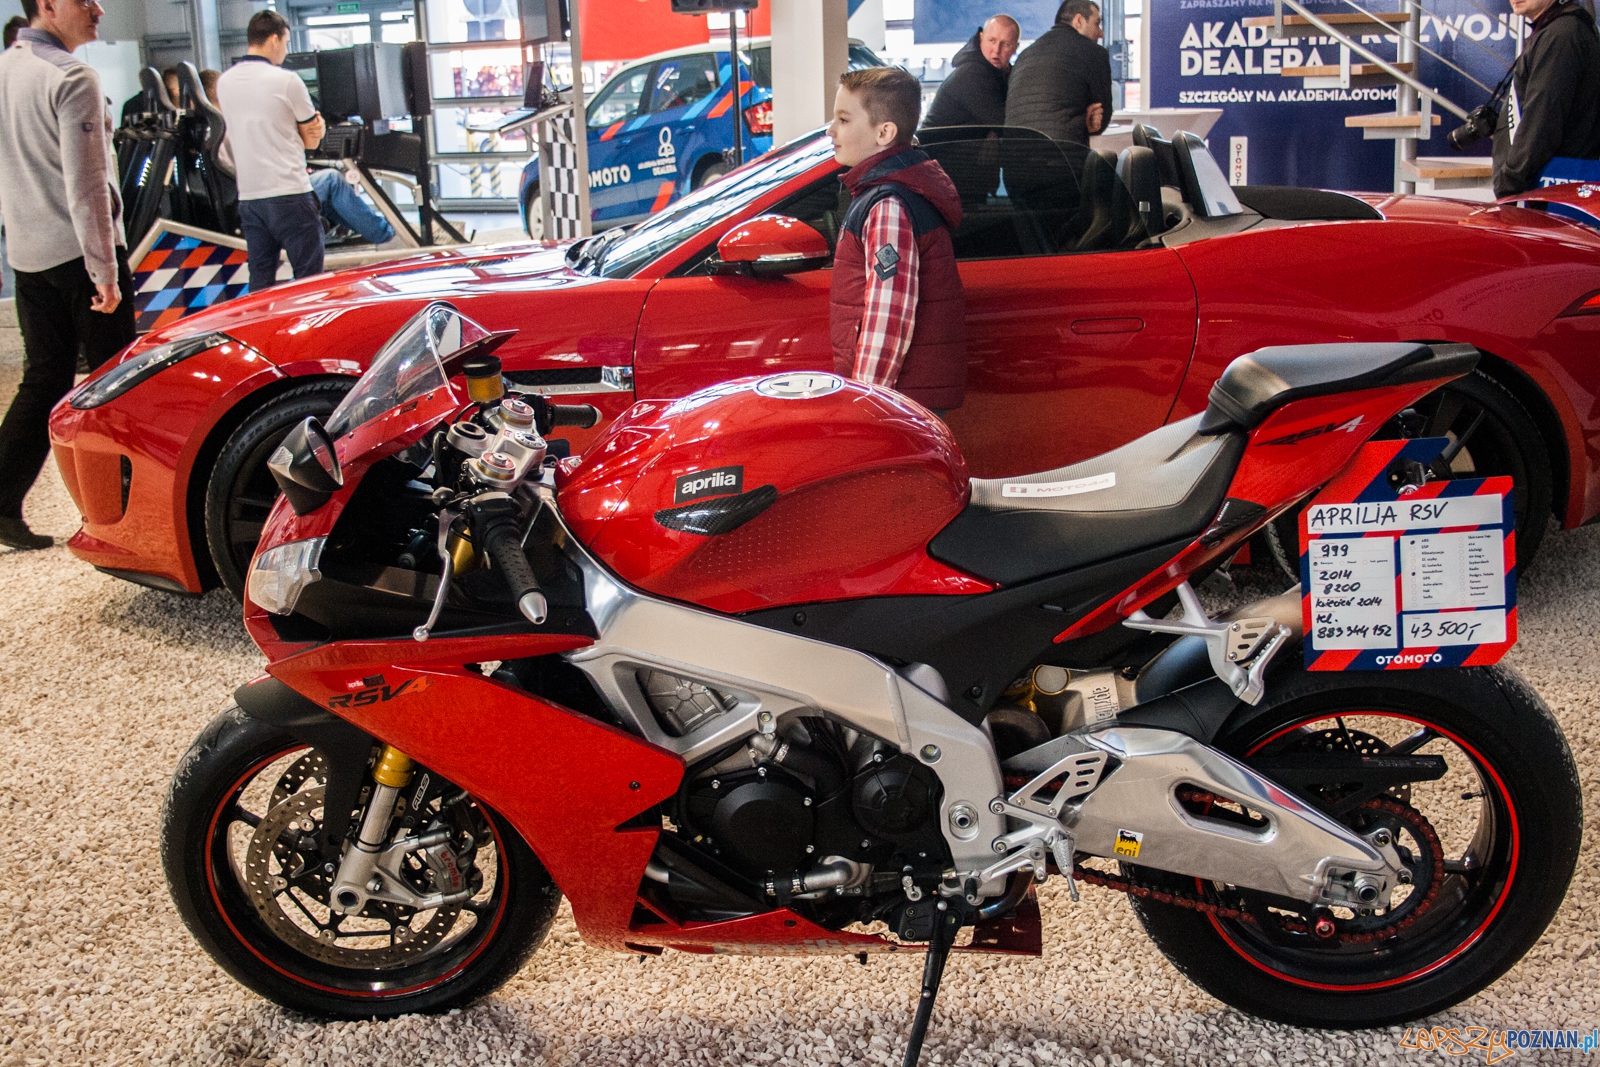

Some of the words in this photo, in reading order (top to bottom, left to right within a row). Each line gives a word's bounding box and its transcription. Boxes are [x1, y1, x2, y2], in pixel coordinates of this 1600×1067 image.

[1180, 21, 1345, 49] AKAD
[1179, 87, 1254, 103] SZCZEGÓŁY
[1256, 89, 1276, 102] NA
[589, 164, 631, 188] MOTO
[681, 472, 737, 494] aprilia
[1409, 501, 1448, 521] RSV
[1320, 544, 1349, 557] 999
[1319, 570, 1352, 581] 2014
[1323, 582, 1361, 595] 8200
[1357, 597, 1382, 607] 2014
[1316, 613, 1338, 624] tel.
[1317, 626, 1343, 639] 883
[1347, 625, 1369, 638] 344
[1372, 624, 1392, 637] 152
[1411, 622, 1433, 638] 43
[1376, 653, 1442, 665] OTOMOTO
[1115, 846, 1138, 857] eni
[440, 851, 461, 888] brembo
